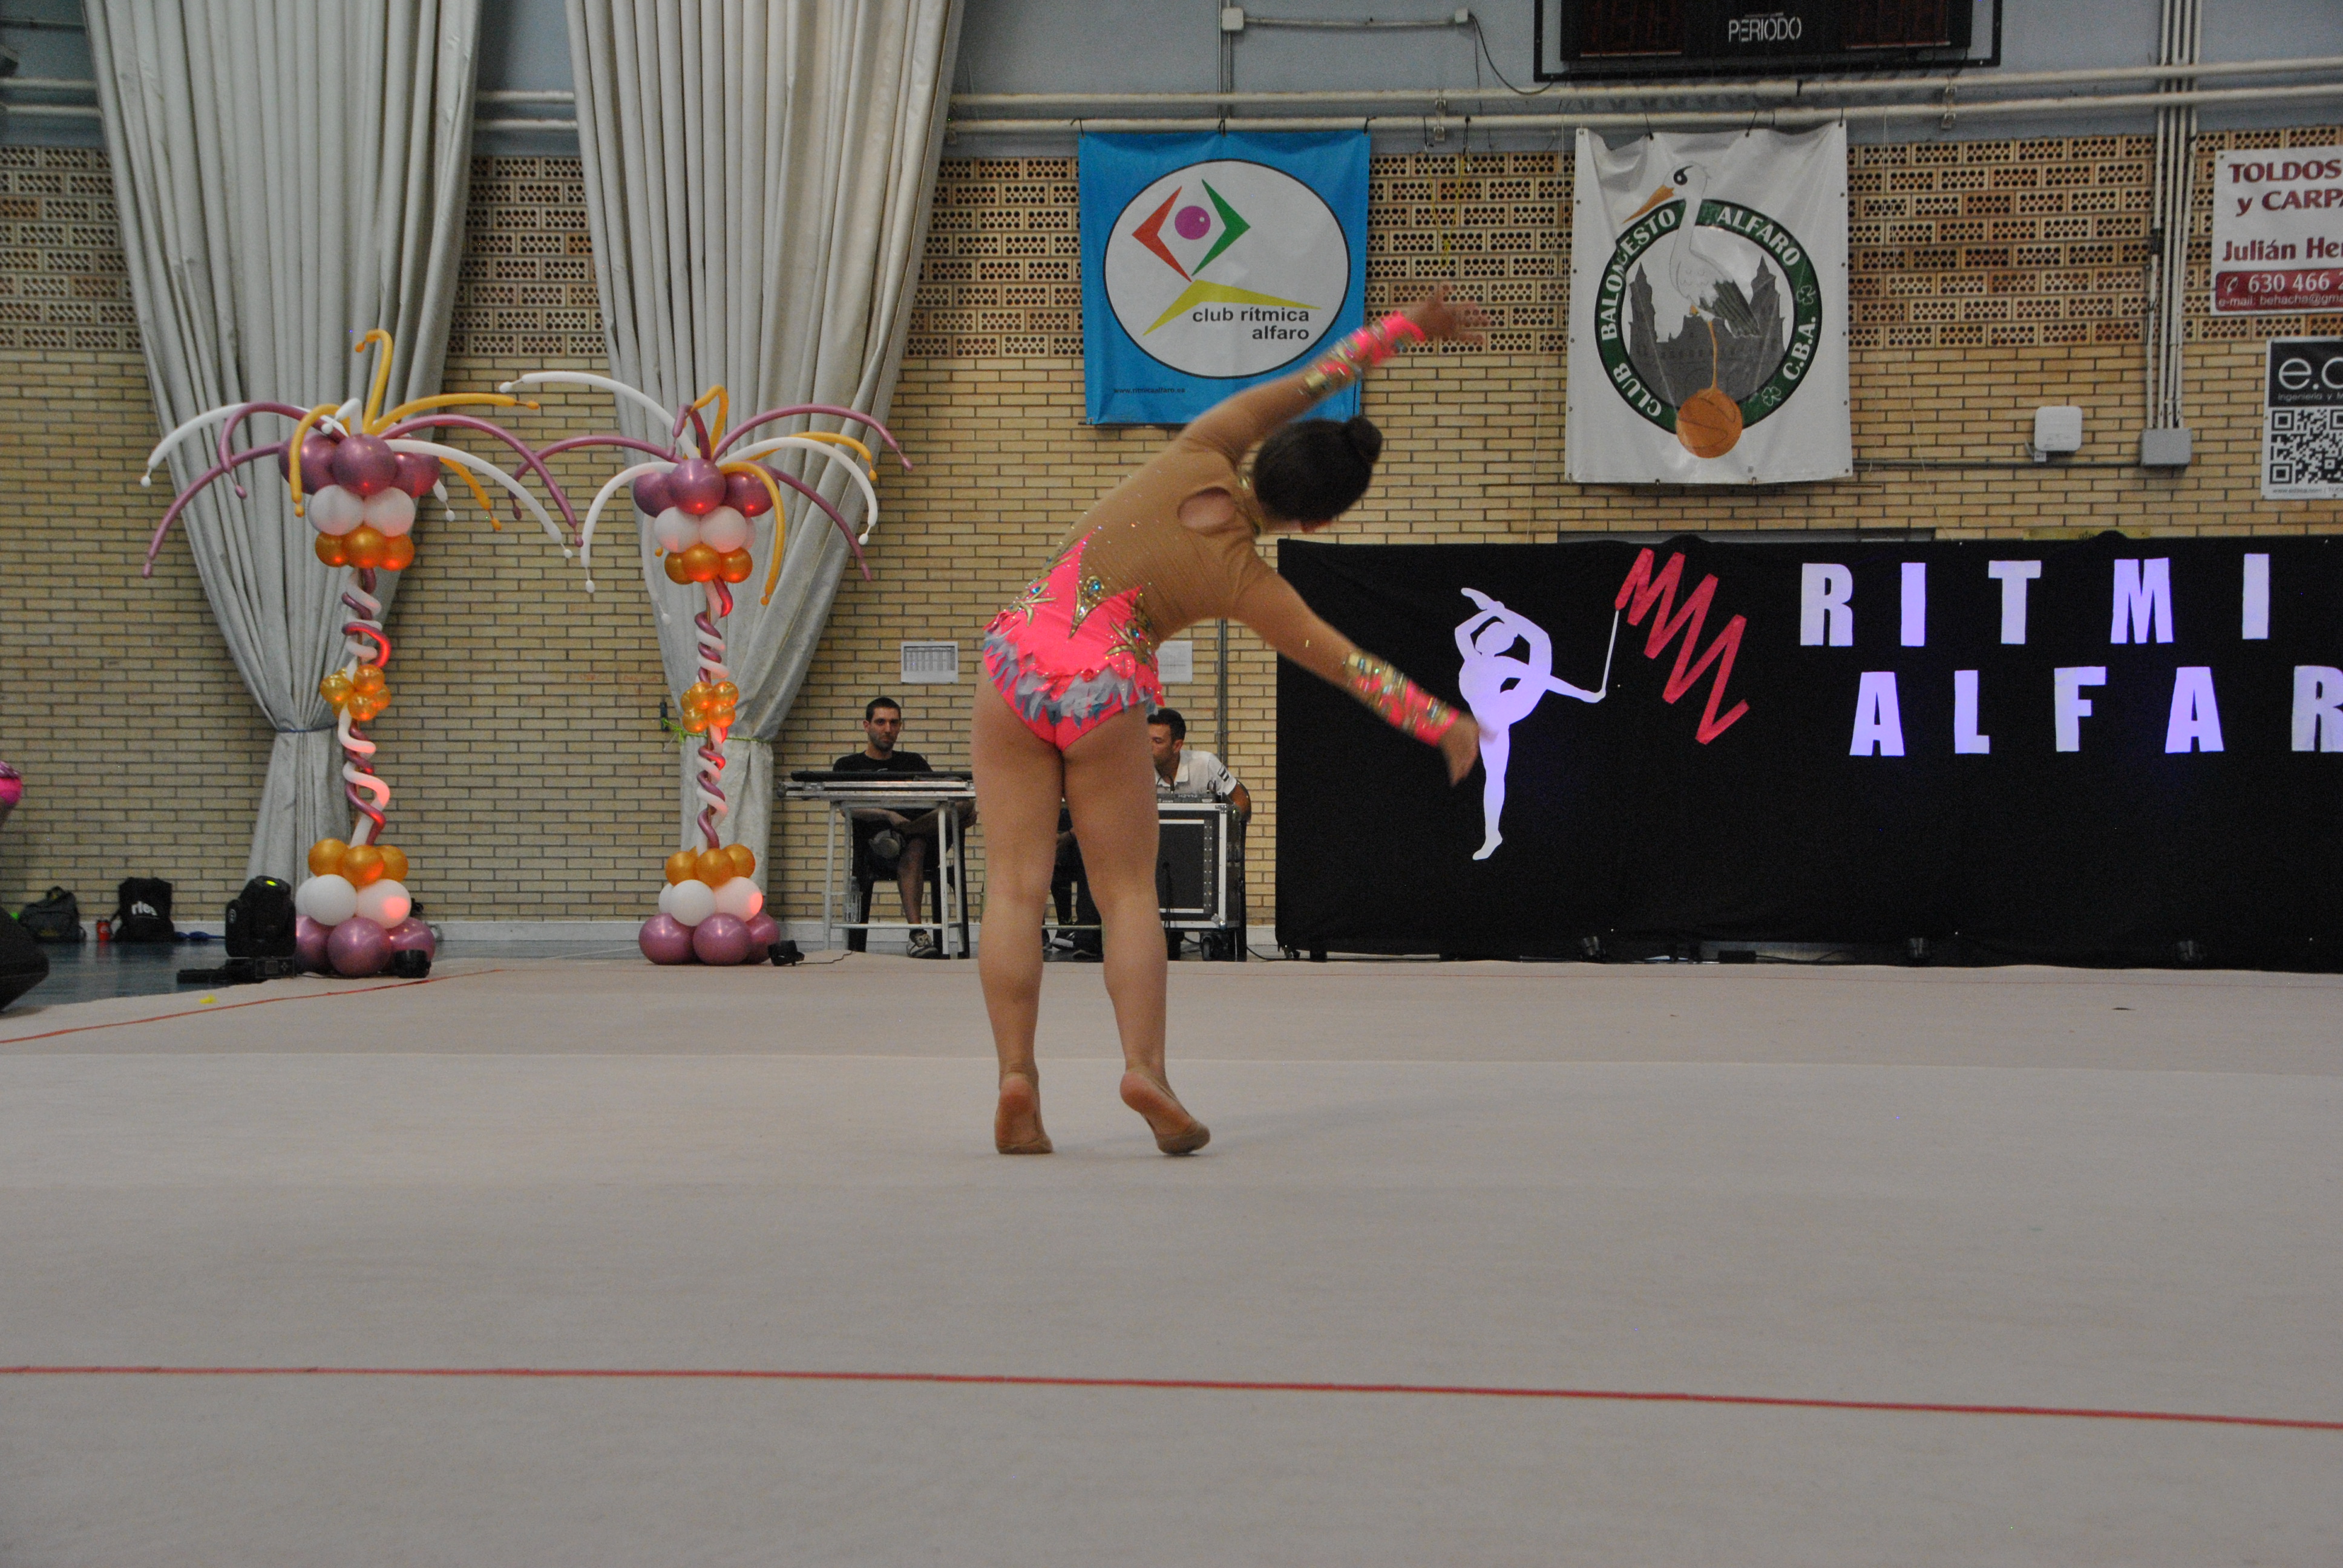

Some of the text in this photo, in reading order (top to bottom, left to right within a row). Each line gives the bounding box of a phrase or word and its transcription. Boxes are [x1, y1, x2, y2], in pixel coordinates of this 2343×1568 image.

[2228, 159, 2342, 183] TOLDOS
[2236, 188, 2343, 217] y CARP
[1717, 206, 1800, 266] ALFARO
[2223, 237, 2343, 262] Julián He
[2248, 273, 2286, 293] 630
[2292, 272, 2330, 292] 466
[1193, 307, 1309, 322] club rítmica
[1252, 325, 1309, 340] alfaro
[1783, 316, 1816, 380] C.B.A.
[1613, 363, 1662, 416] CLUB
[1849, 665, 2343, 756] ALFAR
